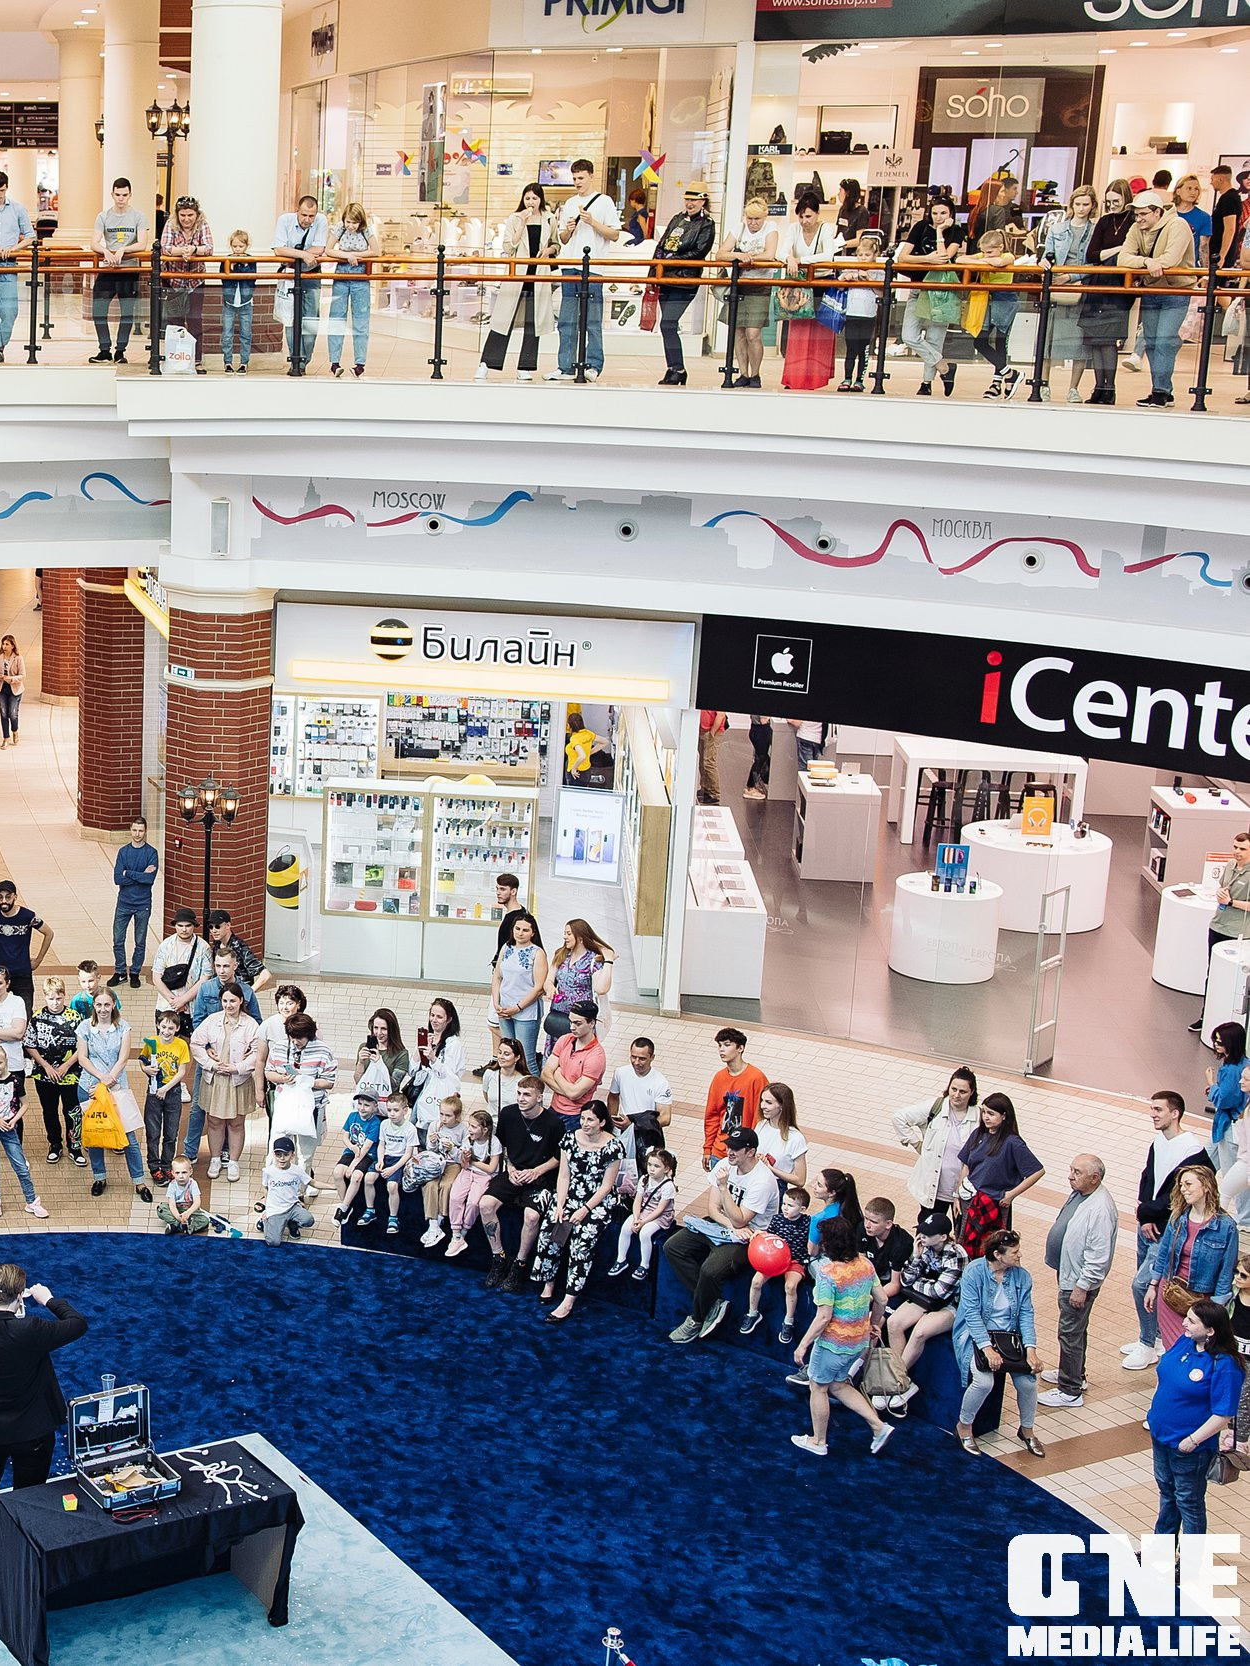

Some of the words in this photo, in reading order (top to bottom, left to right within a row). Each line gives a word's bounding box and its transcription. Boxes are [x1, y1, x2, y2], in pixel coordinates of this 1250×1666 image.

[168, 351, 191, 361] zolla
[372, 490, 447, 511] MOSCOW
[422, 624, 577, 668] Билайн
[757, 678, 783, 687] Premium
[782, 680, 805, 689] Reseller
